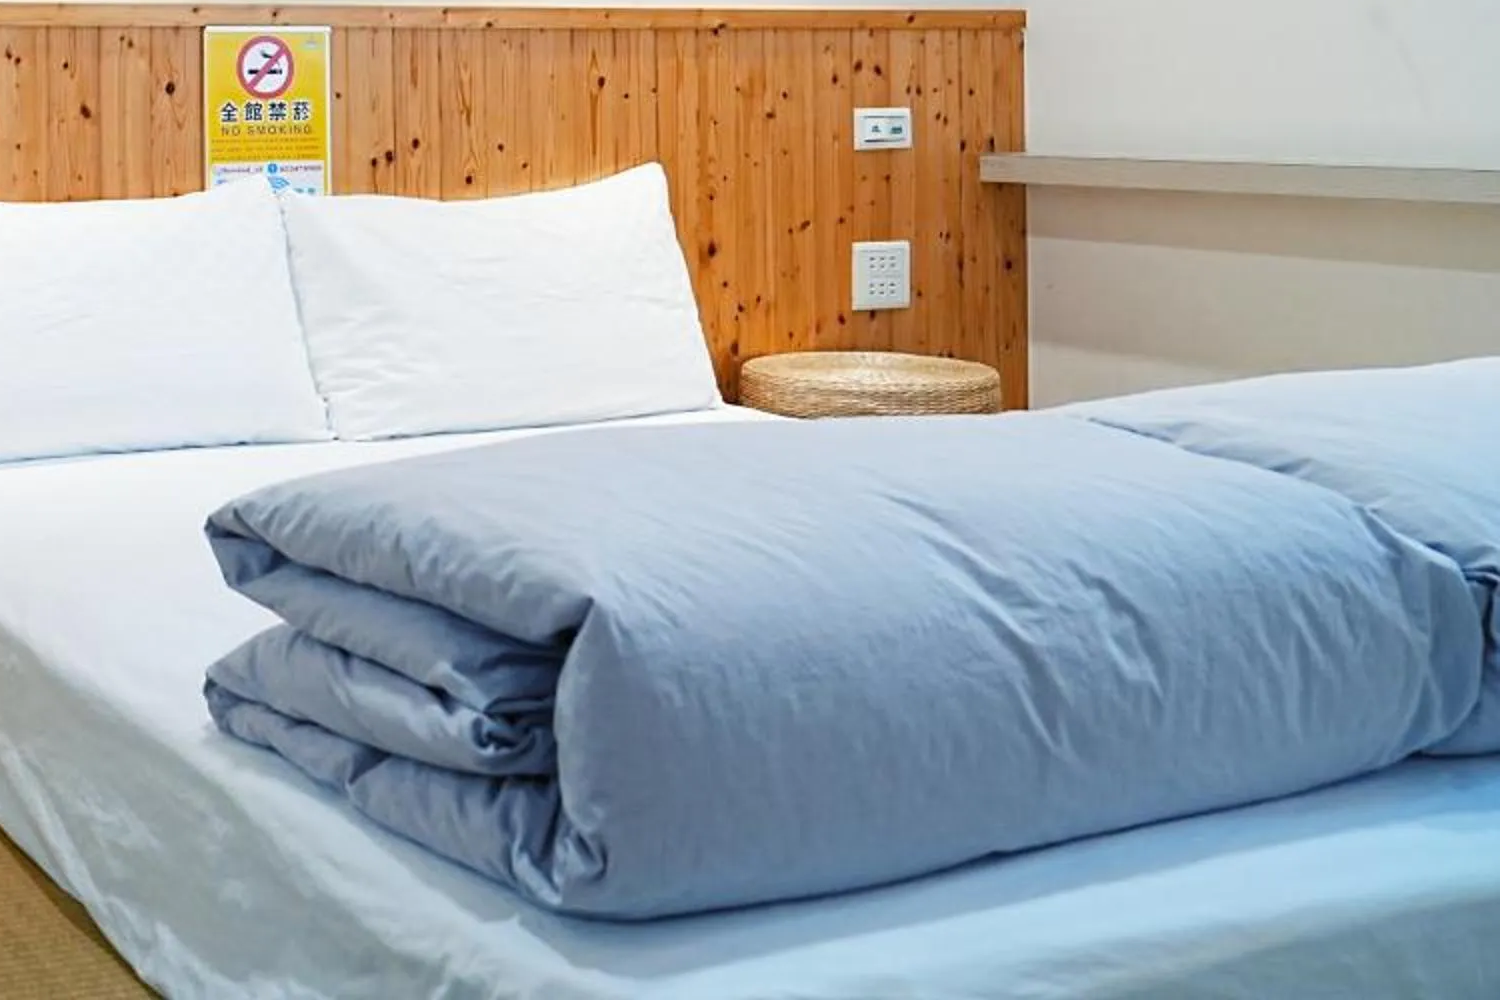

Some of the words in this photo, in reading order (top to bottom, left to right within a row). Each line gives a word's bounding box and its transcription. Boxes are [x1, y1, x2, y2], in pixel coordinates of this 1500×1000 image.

[220, 101, 310, 122] 全館禁菸
[221, 126, 240, 136] NO
[248, 124, 312, 135] SMOKING
